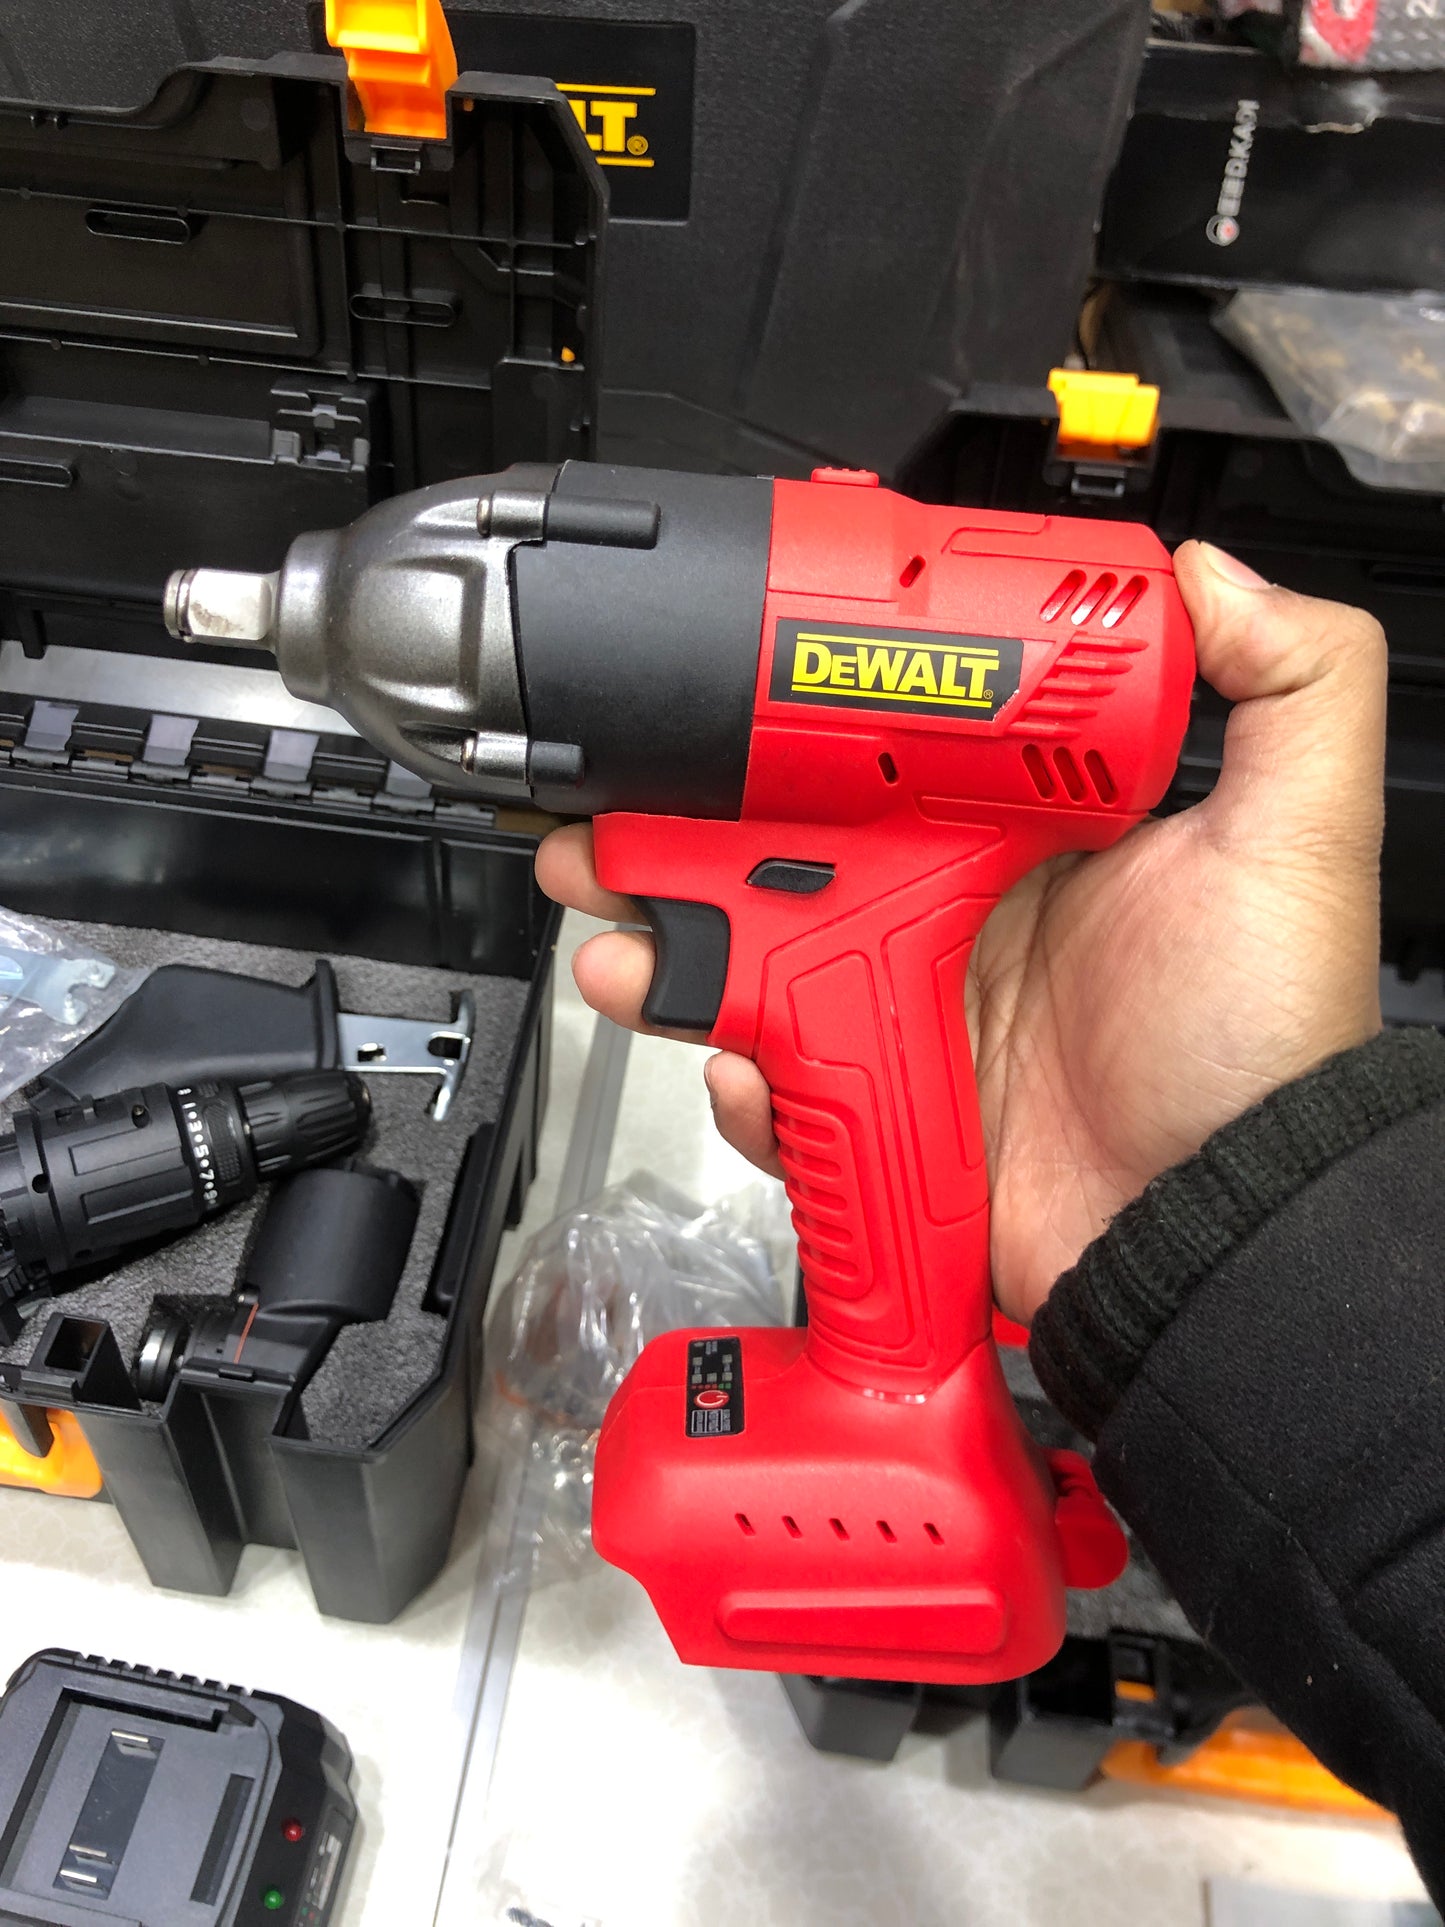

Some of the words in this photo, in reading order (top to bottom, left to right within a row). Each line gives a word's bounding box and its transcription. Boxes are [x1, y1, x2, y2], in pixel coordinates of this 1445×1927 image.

[187, 1120, 203, 1133] 3
[193, 1143, 209, 1158] 5
[199, 1168, 215, 1180] 7
